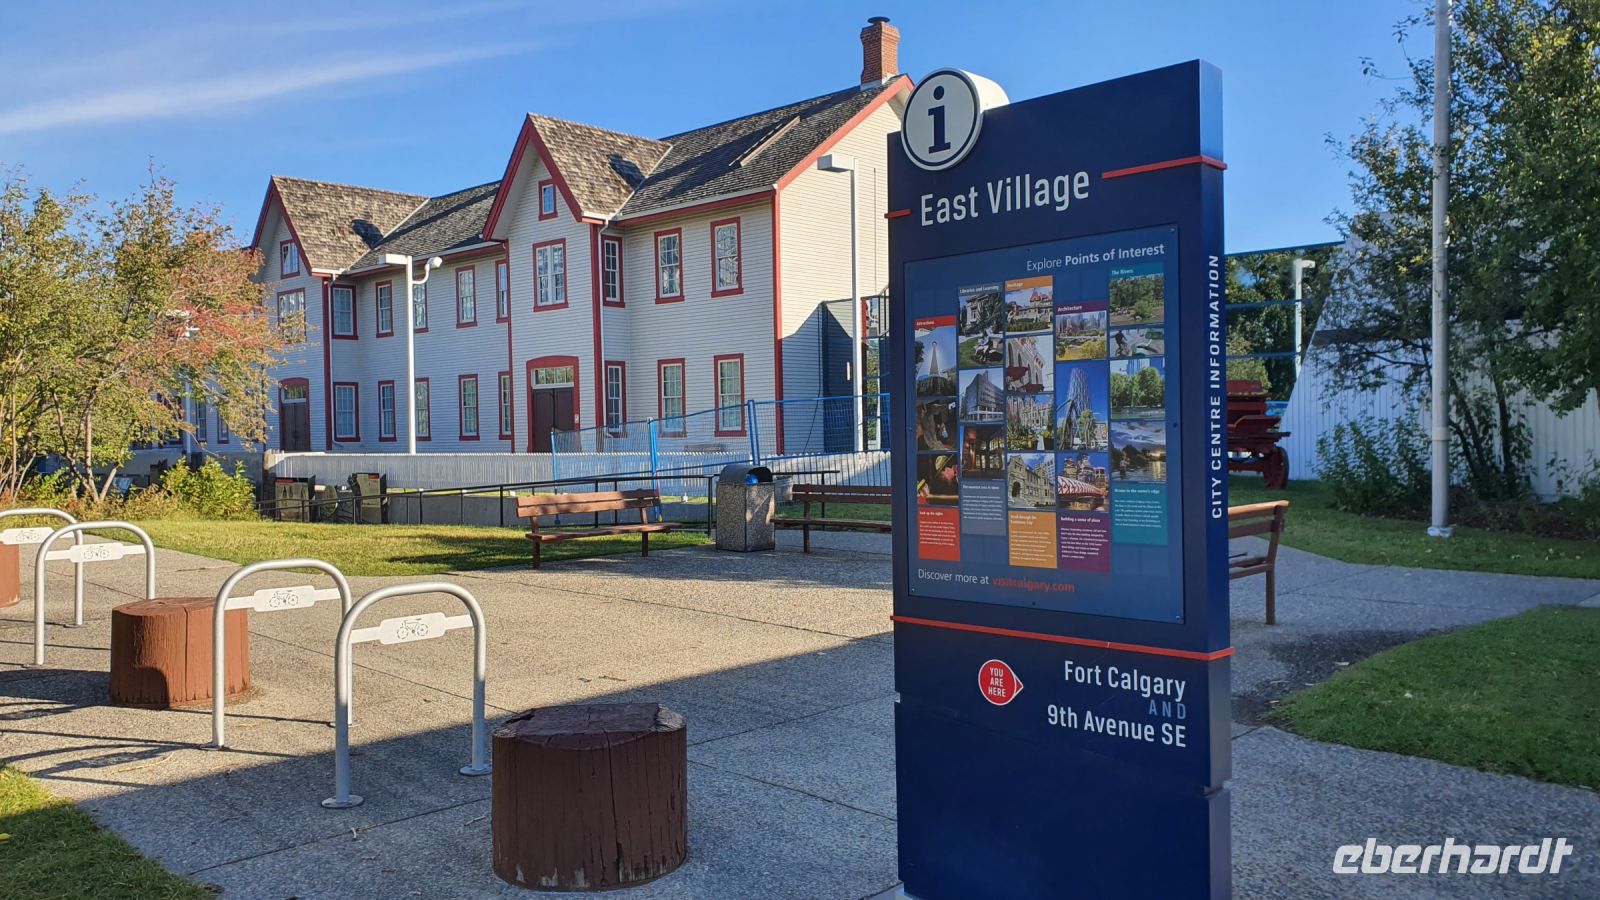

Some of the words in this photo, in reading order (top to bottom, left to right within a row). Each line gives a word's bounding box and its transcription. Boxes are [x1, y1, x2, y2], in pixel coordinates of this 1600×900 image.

[921, 185, 979, 227] East
[987, 170, 1090, 212] Village
[1026, 256, 1062, 272] Explore
[1065, 252, 1100, 266] Points
[1102, 248, 1115, 261] of
[1118, 243, 1165, 259] Interest
[1208, 255, 1221, 389] INFORMATION
[1210, 396, 1222, 471] CENTRE
[1211, 476, 1223, 519] CITY
[918, 568, 952, 581] Discover
[955, 573, 978, 584] more
[980, 575, 990, 585] at
[992, 577, 1075, 593] visitcalgary.com
[989, 667, 1004, 678] YOU
[989, 677, 1004, 687] ARE
[1064, 660, 1102, 686] Fort
[1108, 667, 1186, 702] Calgary
[988, 687, 1006, 698] HERE
[1148, 699, 1186, 720] AND
[1047, 704, 1078, 729] 9th
[1084, 710, 1155, 742] Avenue
[1161, 722, 1187, 748] SE
